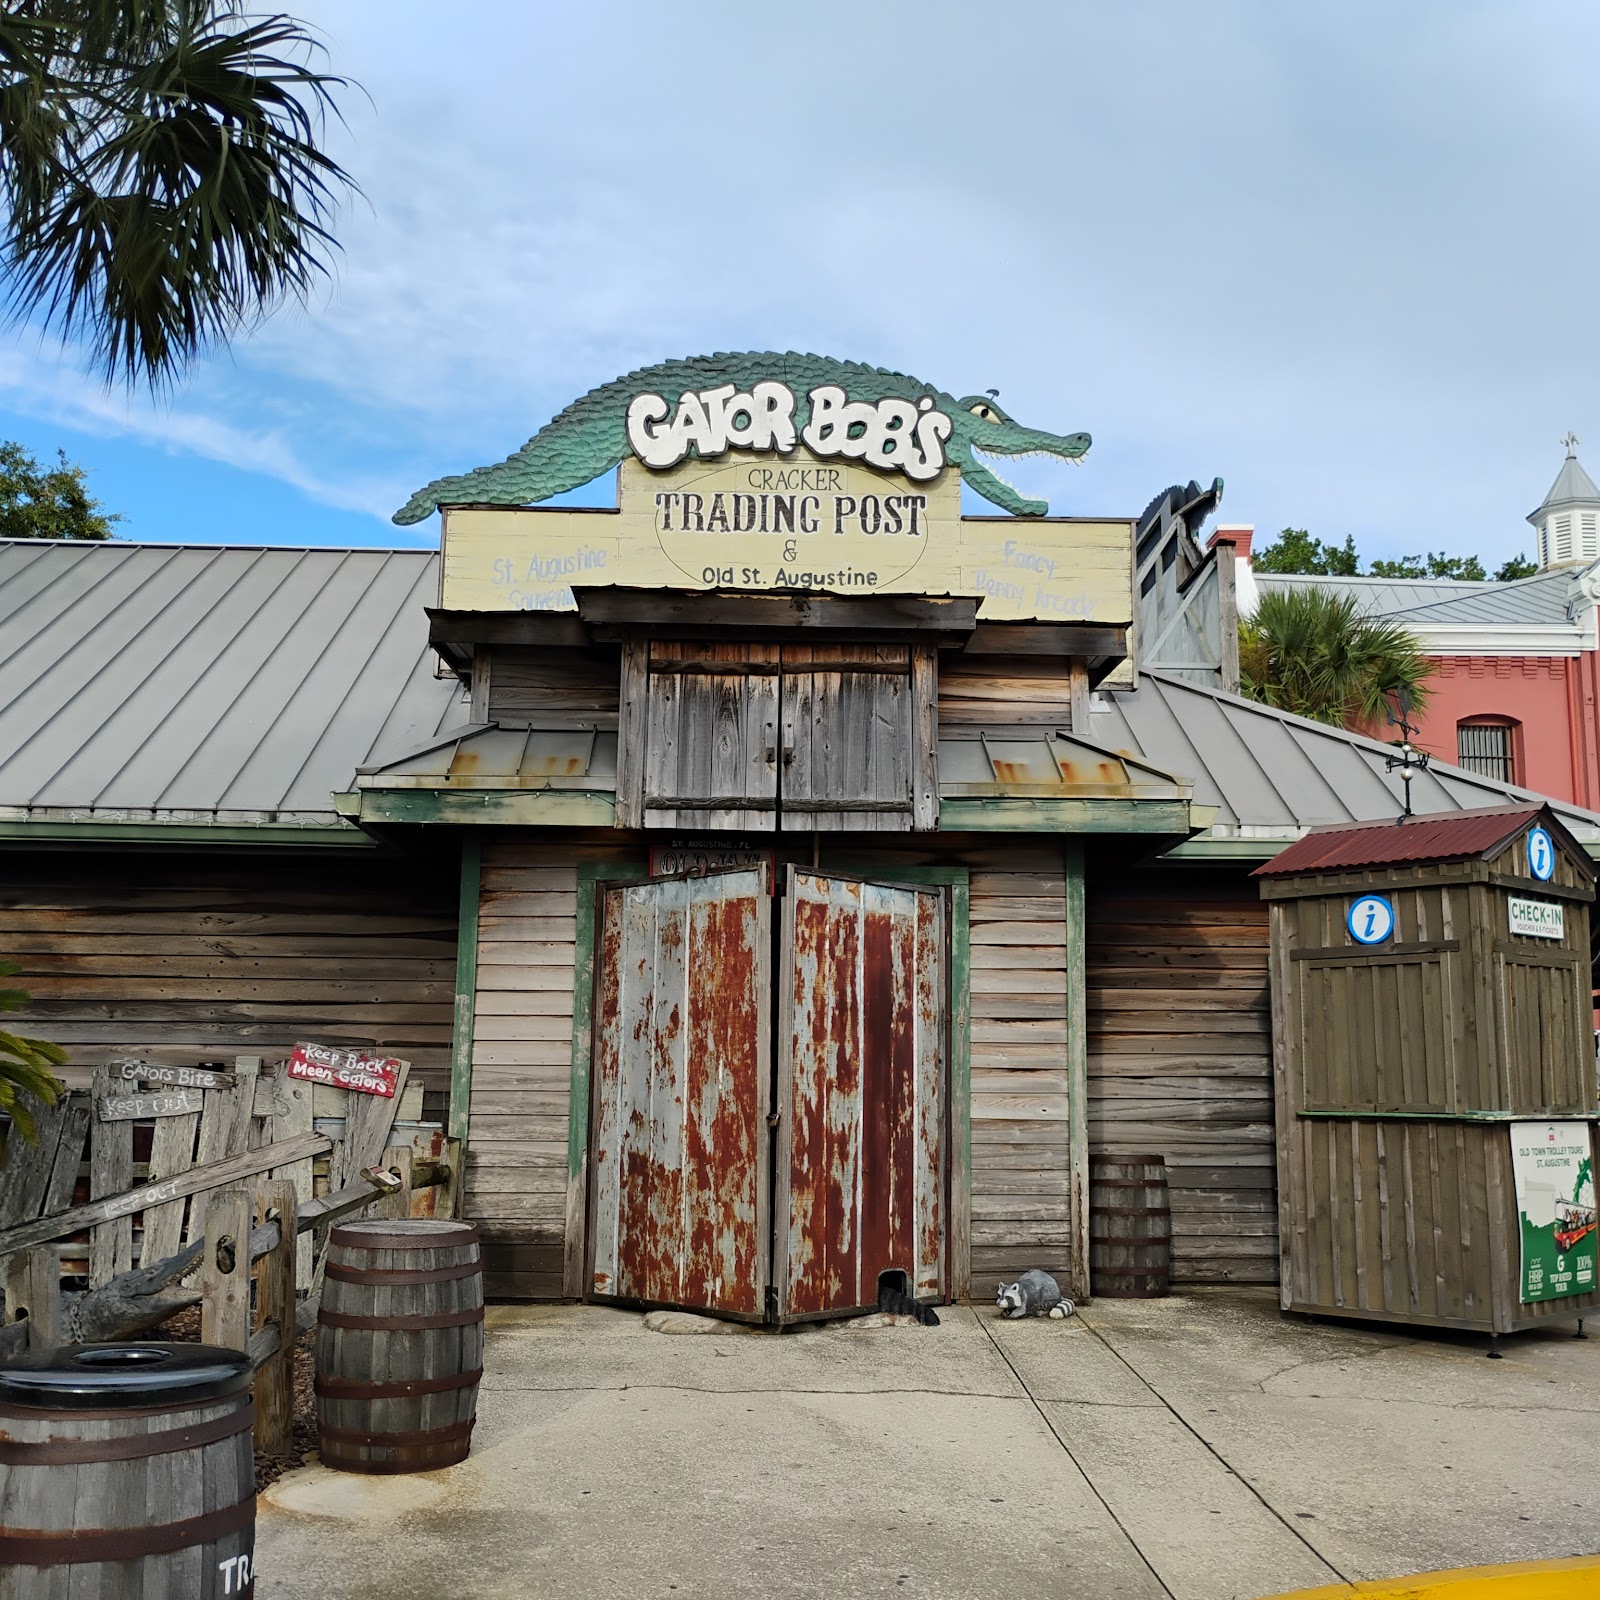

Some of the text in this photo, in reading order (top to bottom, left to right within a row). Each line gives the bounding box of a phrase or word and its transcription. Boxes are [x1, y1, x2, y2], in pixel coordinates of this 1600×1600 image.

[626, 380, 952, 482] GATOR BOB'S
[748, 468, 843, 491] CRACKER
[655, 493, 926, 536] TRADING POST
[783, 539, 798, 562] &
[1003, 540, 1055, 581] Fancy
[491, 544, 608, 585] St. Augustine
[702, 567, 879, 588] Old St. Augustine
[975, 569, 1099, 622] Penny Arcade
[1511, 902, 1562, 926] CHECK-IN
[1517, 923, 1535, 932] VOUCHER
[304, 1043, 386, 1074] Keep Back
[178, 1068, 217, 1087] Bite
[338, 1069, 387, 1093] Gators
[1519, 1147, 1531, 1157] OLD
[1531, 1146, 1546, 1156] TOWN
[1546, 1146, 1567, 1156] TROLLEY
[1536, 1158, 1571, 1168] ST. AUGUSTINE
